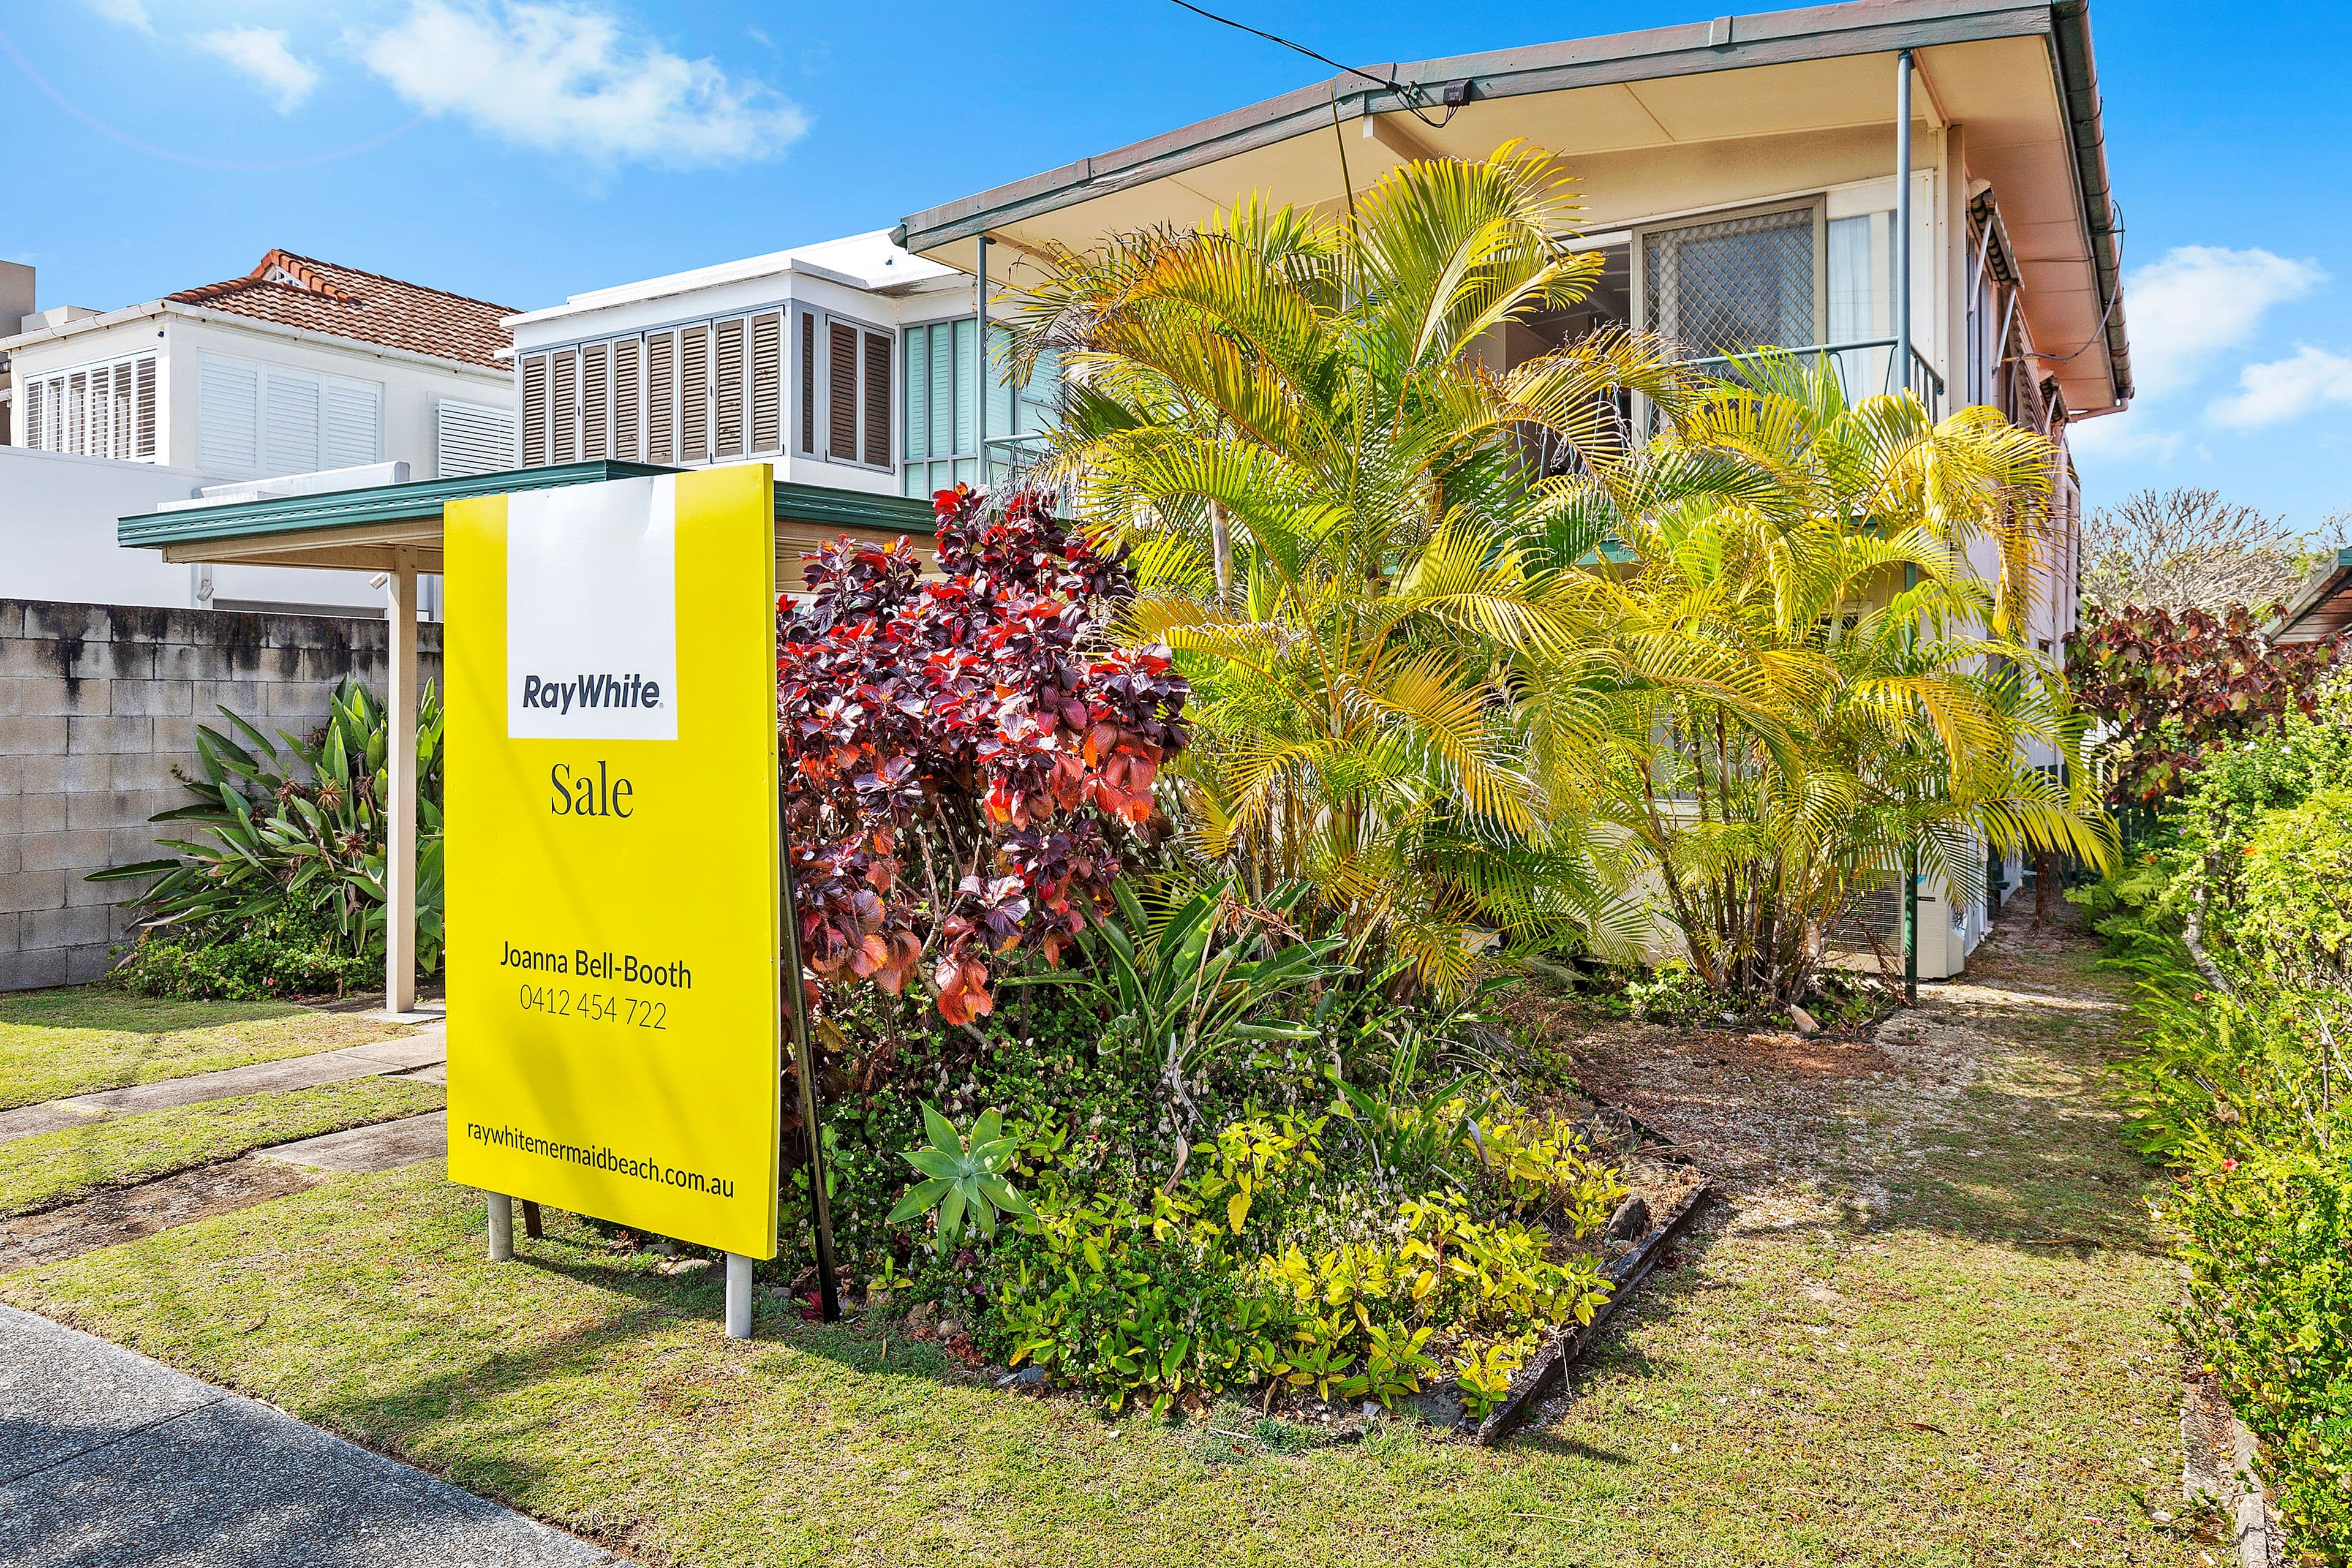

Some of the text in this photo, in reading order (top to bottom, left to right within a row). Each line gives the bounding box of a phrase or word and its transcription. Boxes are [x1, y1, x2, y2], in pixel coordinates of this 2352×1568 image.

[551, 760, 634, 818] Sale
[500, 940, 692, 989] Joanna Bell-Booth
[520, 984, 667, 1030] 0412 454 722
[467, 1121, 734, 1199] raywhitemermaidbeach.com.au
